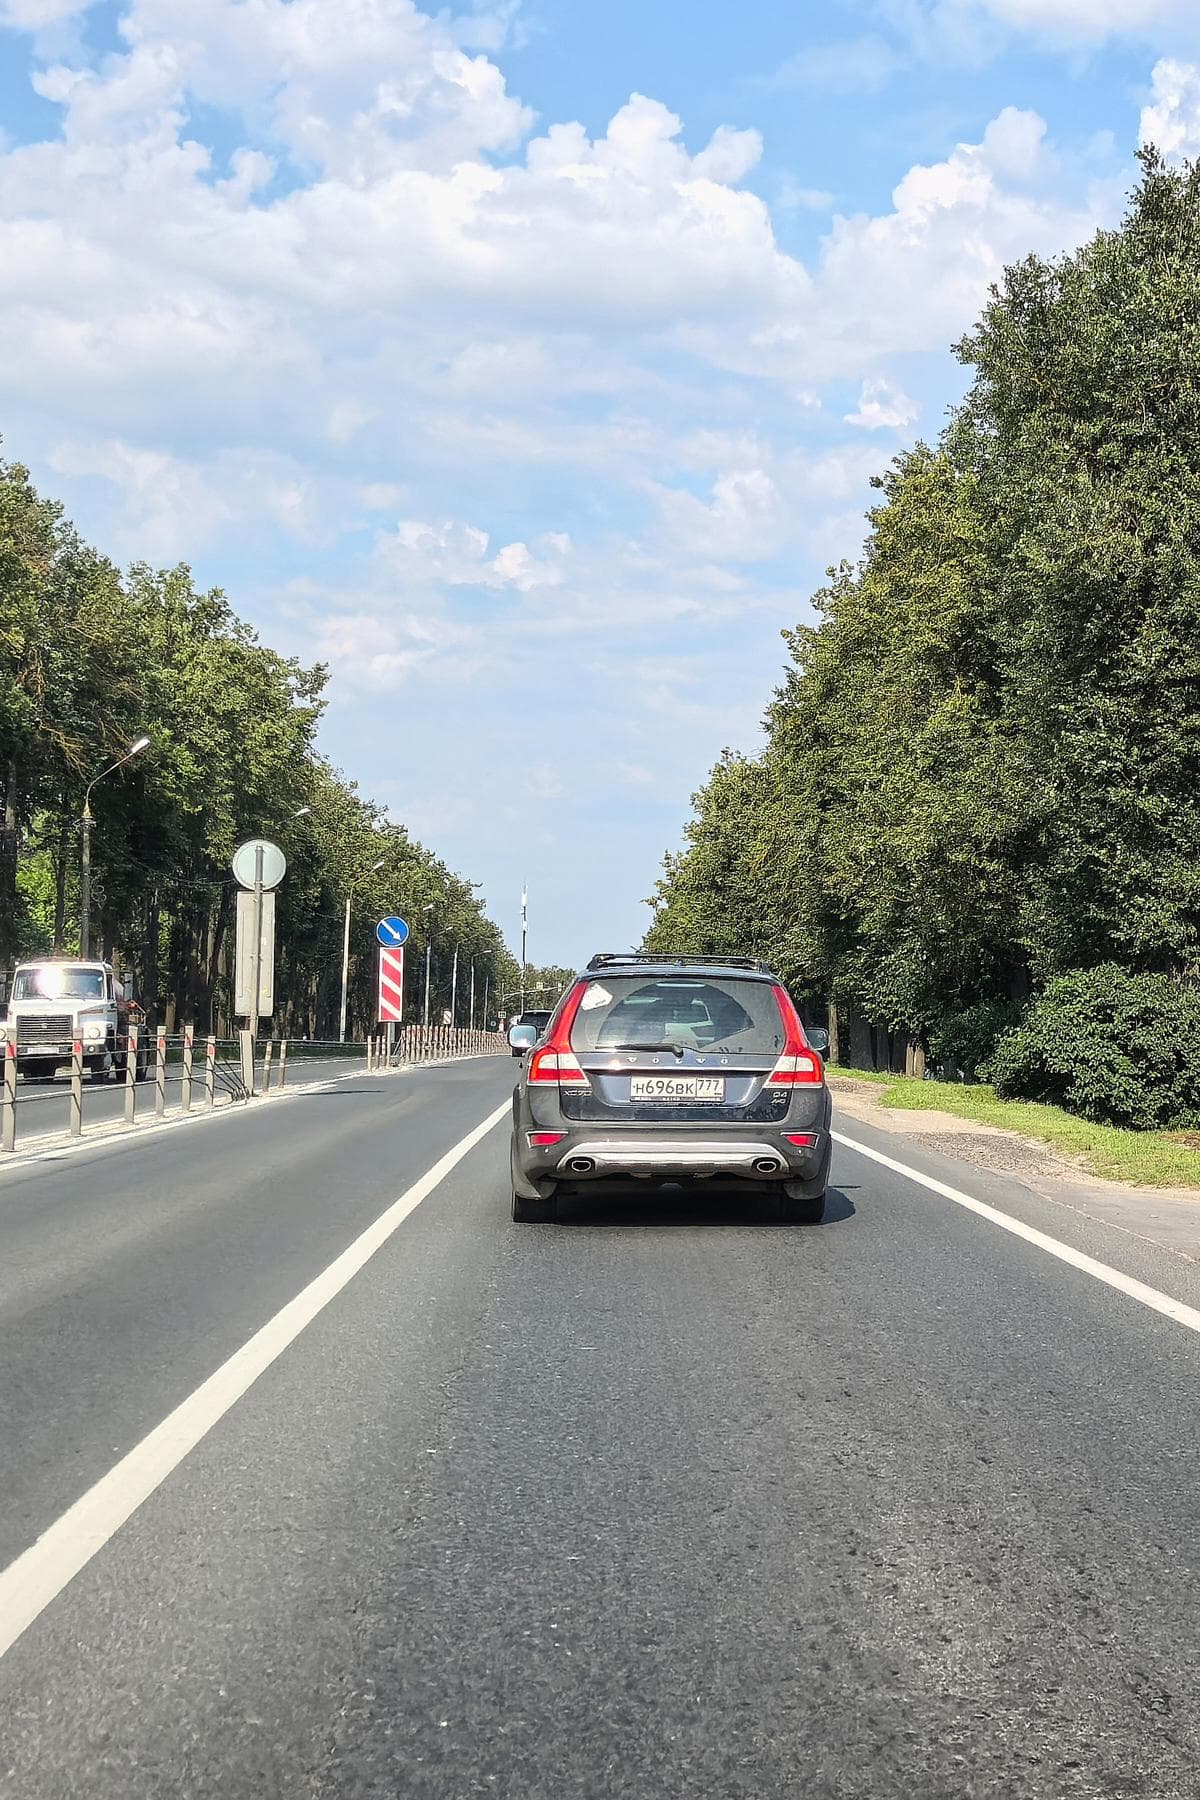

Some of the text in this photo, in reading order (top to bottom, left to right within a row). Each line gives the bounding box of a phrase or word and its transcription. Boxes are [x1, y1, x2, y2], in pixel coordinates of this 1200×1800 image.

[627, 1056, 728, 1064] VOLVO
[636, 1079, 720, 1095] Н696ВК 777
